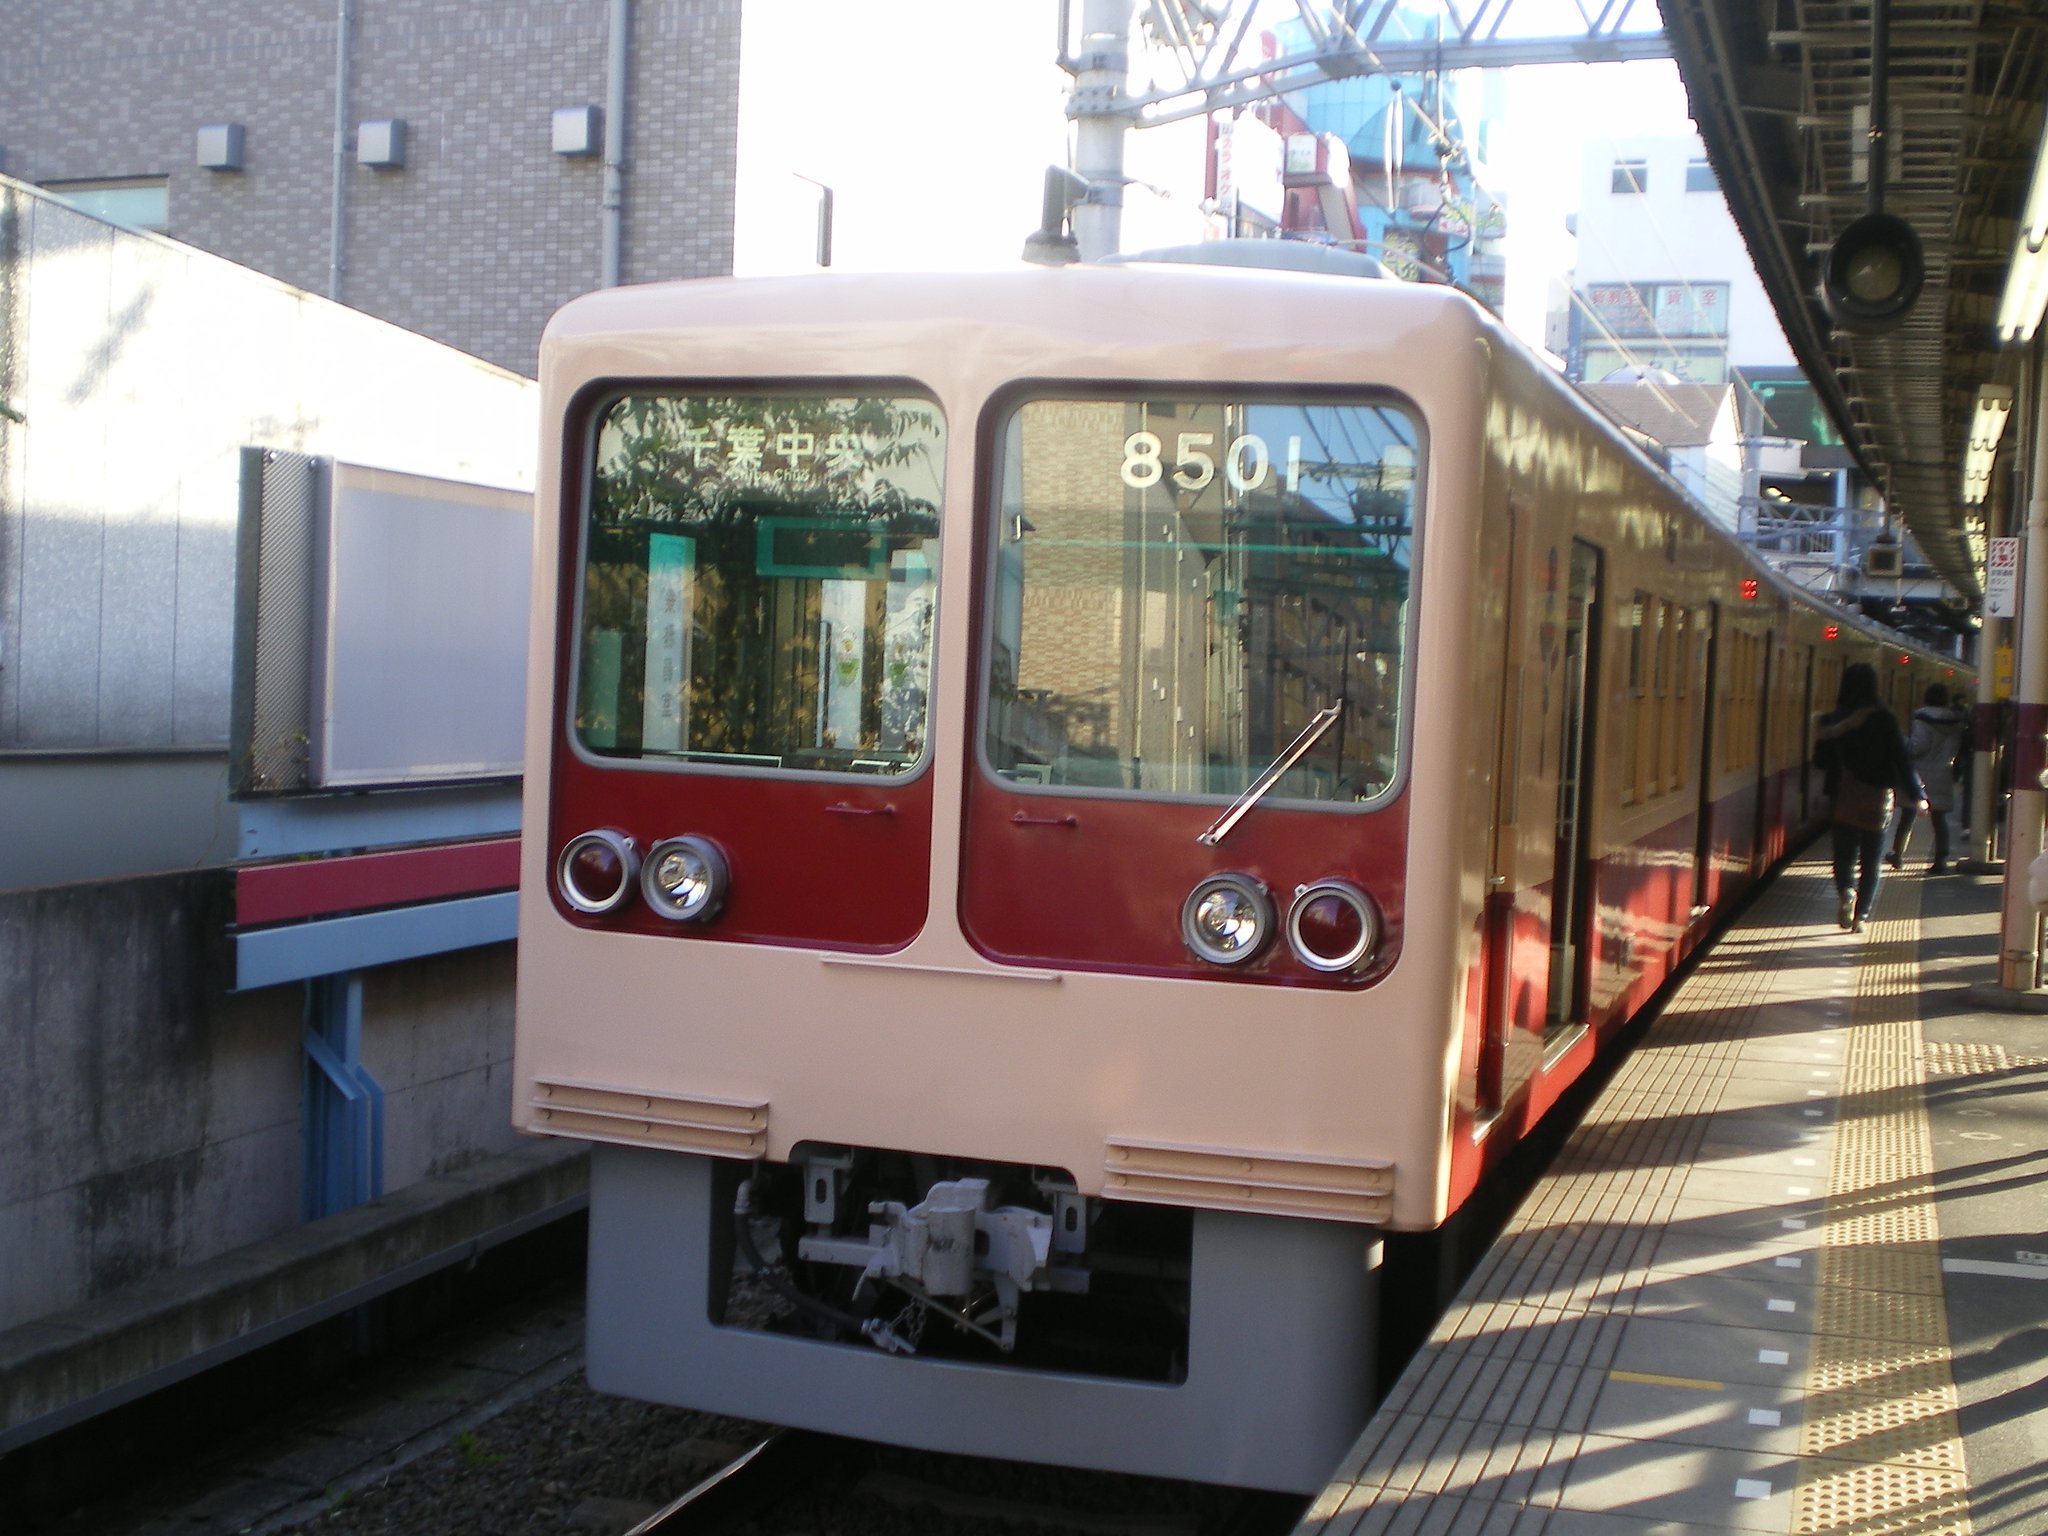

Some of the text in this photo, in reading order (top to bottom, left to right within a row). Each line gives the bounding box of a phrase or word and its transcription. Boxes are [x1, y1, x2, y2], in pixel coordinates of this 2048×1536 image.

[679, 424, 865, 468] 千葉中央
[1120, 431, 1302, 494] 8501
